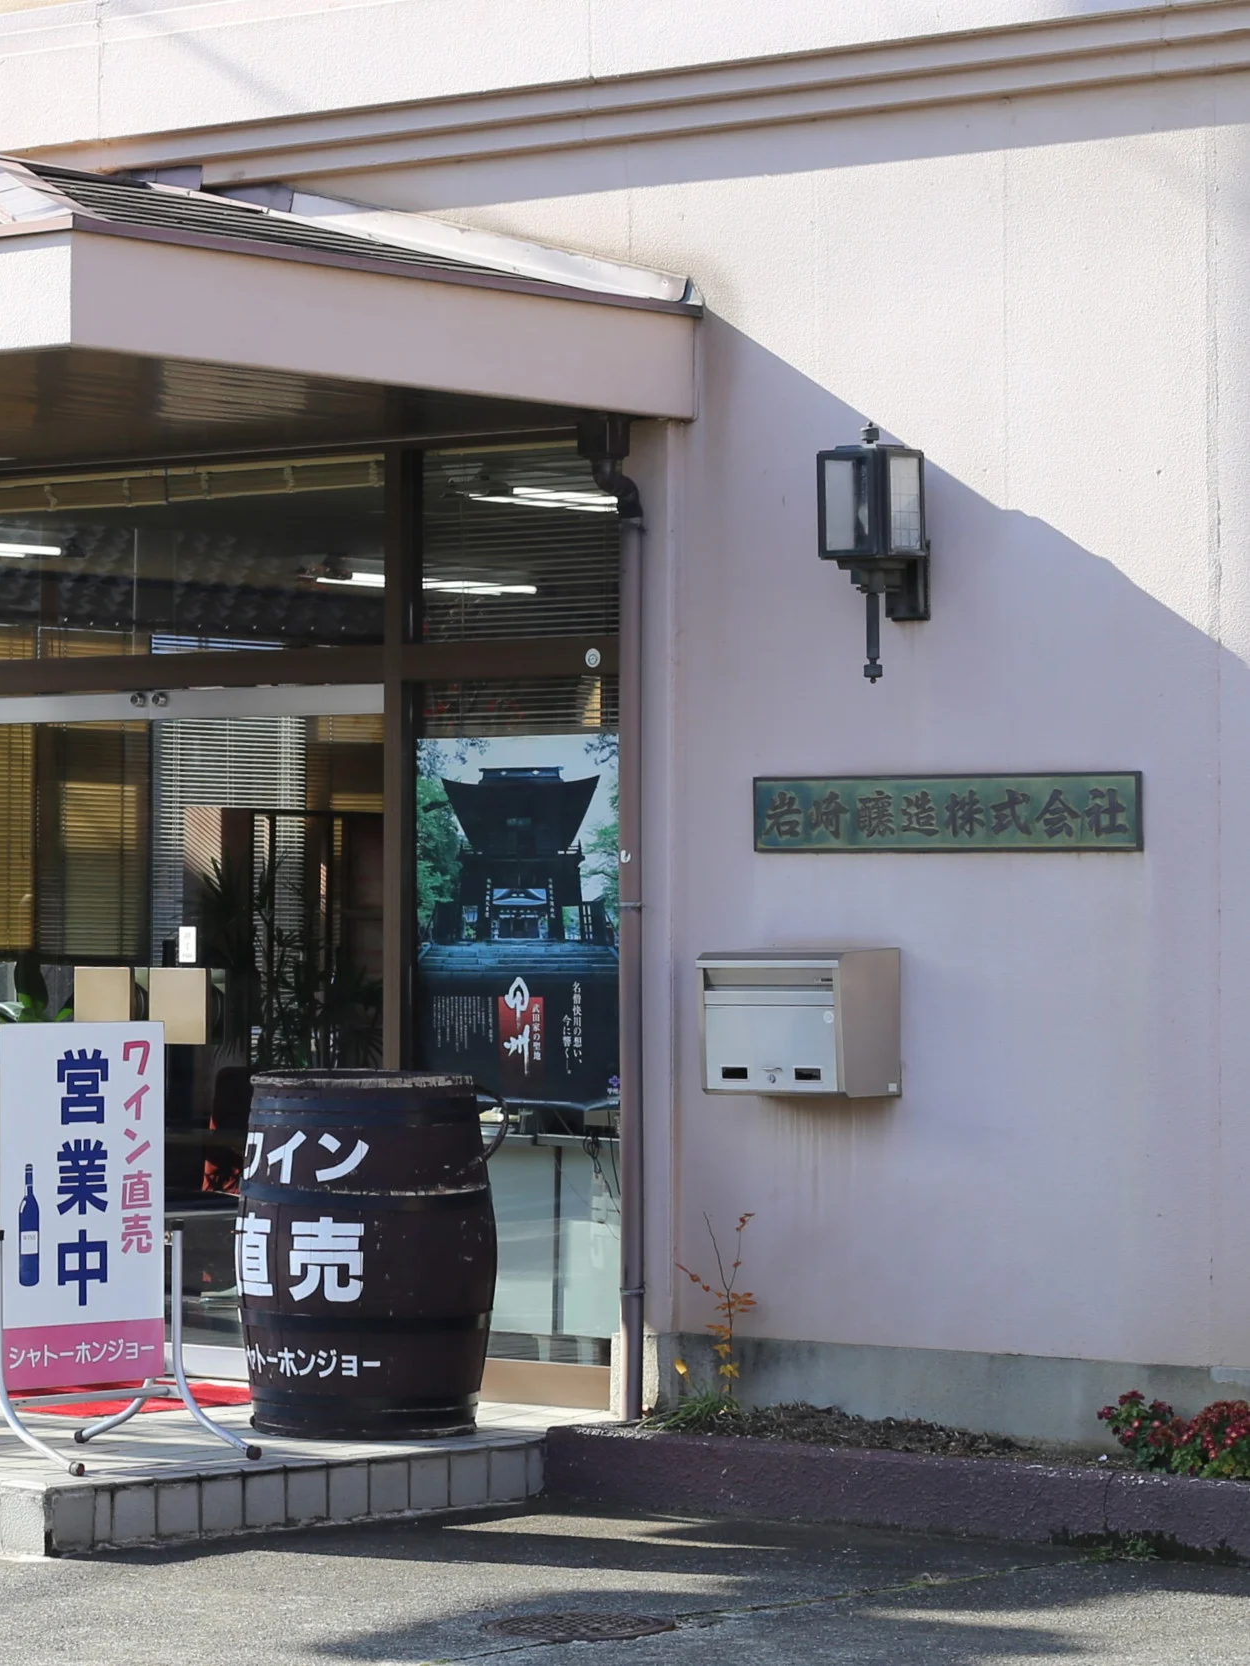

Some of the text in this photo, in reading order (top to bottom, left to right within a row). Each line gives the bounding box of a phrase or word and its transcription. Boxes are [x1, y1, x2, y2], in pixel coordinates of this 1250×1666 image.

[532, 1003, 541, 1061] 武田家の聖地
[57, 1048, 108, 1306] 営業中
[121, 1040, 153, 1254] ワイン直売
[243, 1130, 369, 1184] ワイン
[235, 1212, 364, 1302] 直売
[8, 1338, 155, 1369] シャトーホンジョー
